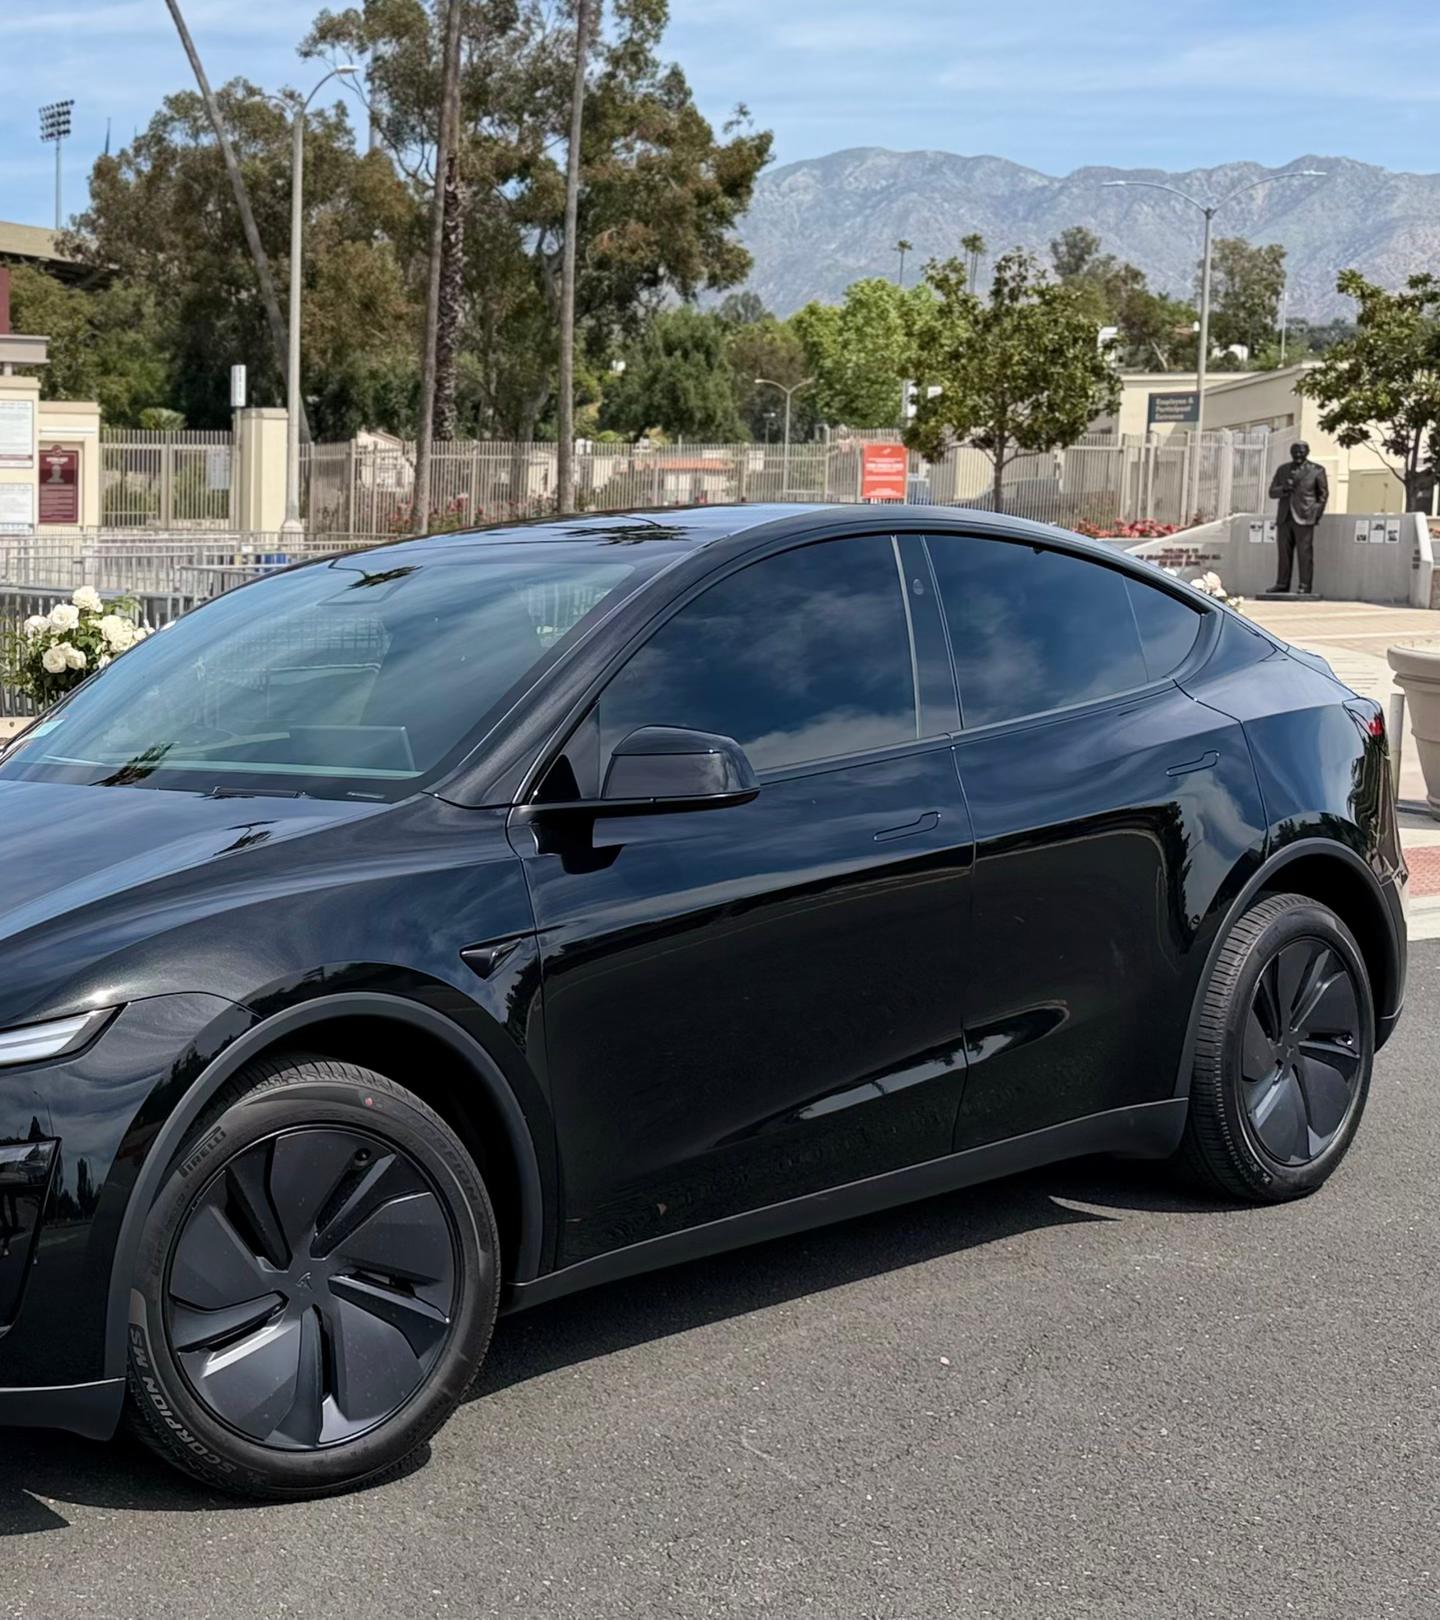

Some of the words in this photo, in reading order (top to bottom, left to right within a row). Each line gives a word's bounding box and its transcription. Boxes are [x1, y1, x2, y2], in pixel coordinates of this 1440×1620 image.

[176, 1126, 228, 1178] PIRELLI
[129, 1327, 150, 1369] MS
[142, 1376, 238, 1474] SCORPION
